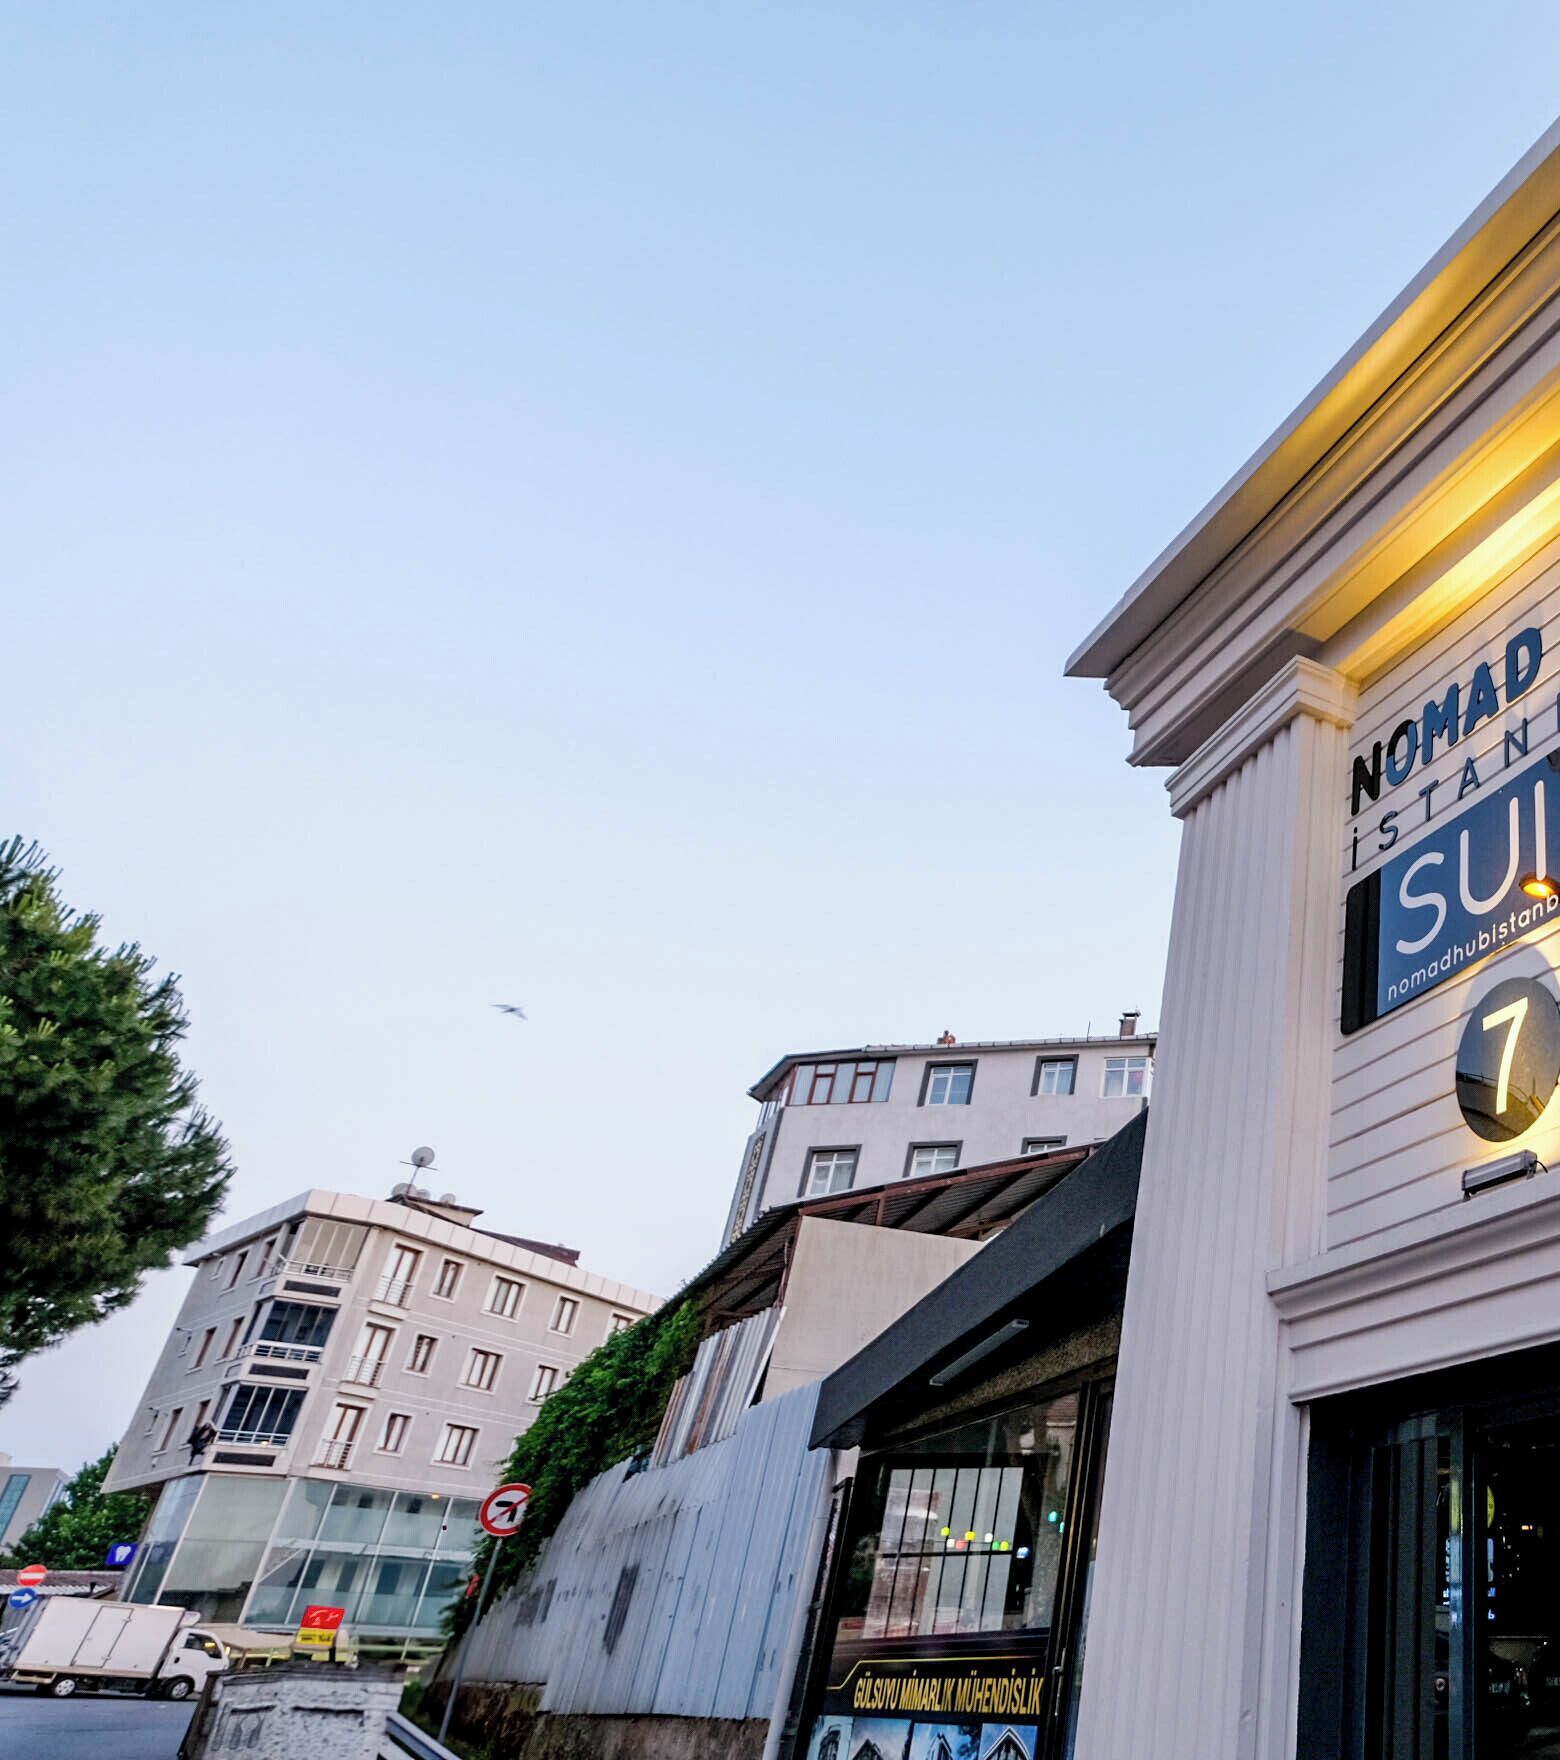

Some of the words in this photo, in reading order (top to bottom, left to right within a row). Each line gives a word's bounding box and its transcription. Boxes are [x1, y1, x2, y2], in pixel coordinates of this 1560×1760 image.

[1351, 627, 1542, 816] NOMAD
[1482, 996, 1529, 1115] 7
[853, 1671, 901, 1710] GÜLSUYU
[899, 1669, 955, 1712] MİMARLIK
[954, 1667, 1044, 1715] MÜHENDİSLİK
